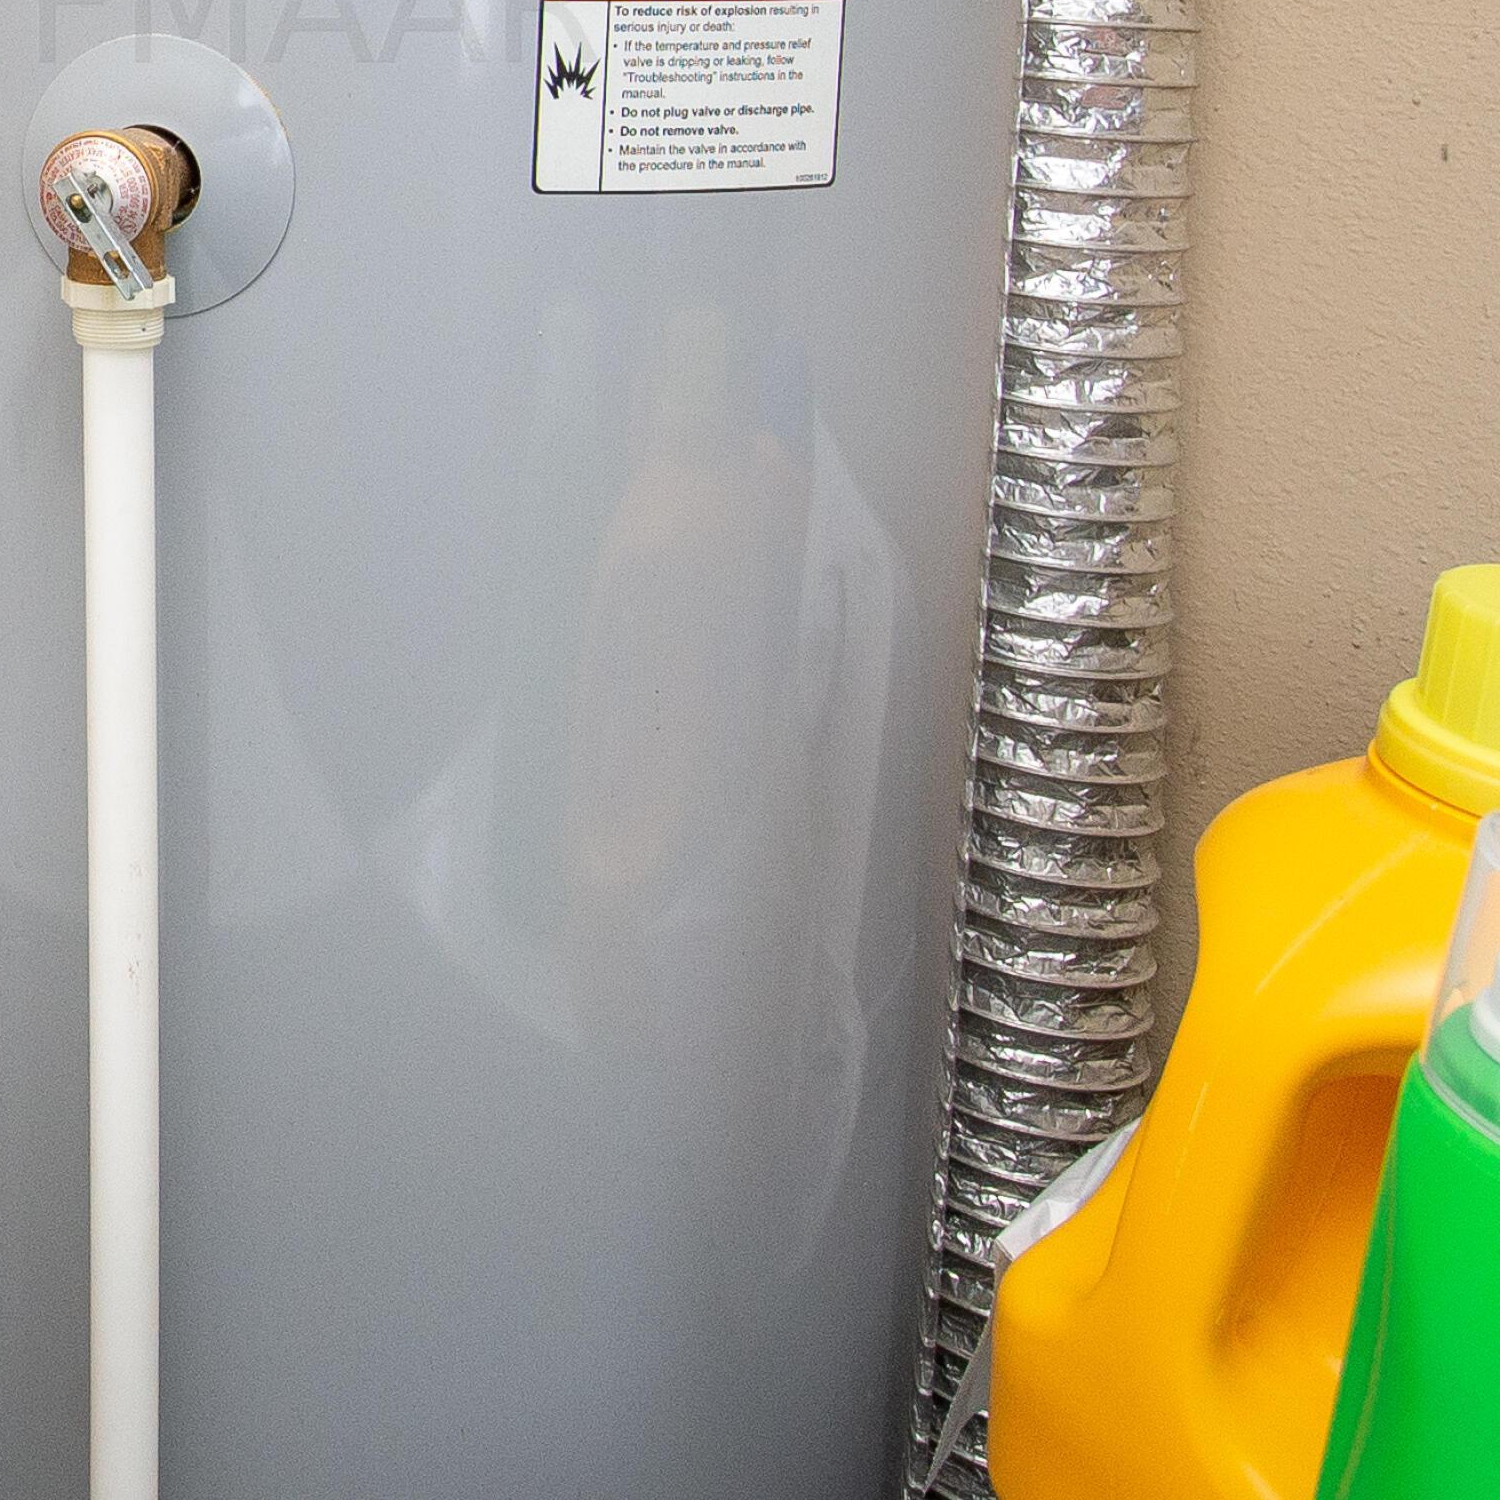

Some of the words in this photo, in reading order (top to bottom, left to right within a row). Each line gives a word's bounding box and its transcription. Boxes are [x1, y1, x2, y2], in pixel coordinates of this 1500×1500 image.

[614, 5, 629, 16] To
[632, 5, 672, 16] reduce
[676, 5, 697, 16] risk
[700, 5, 711, 16] of
[714, 5, 766, 17] explosion
[768, 5, 809, 17] resulting
[810, 5, 819, 14] in
[613, 22, 654, 32] serious
[657, 22, 686, 34] injury
[688, 23, 700, 32] or
[624, 40, 631, 51] If
[634, 40, 652, 51] the
[722, 40, 741, 50] and
[743, 40, 786, 52] pressure
[788, 38, 811, 49] relief
[623, 56, 652, 67] valve
[655, 56, 664, 66] is
[667, 56, 710, 68] dripping
[712, 57, 723, 66] or
[777, 70, 786, 80] in
[788, 70, 803, 79] the
[621, 106, 637, 117] Do
[640, 107, 660, 117] not
[663, 106, 688, 119] plug
[692, 106, 720, 116] valve
[723, 107, 735, 116] or
[737, 104, 788, 117] discharge
[620, 125, 637, 136] Do
[639, 125, 659, 136] not
[662, 127, 704, 136] remove
[619, 143, 665, 155] Maintain
[668, 143, 685, 154] the
[688, 143, 715, 154] valve
[718, 143, 727, 153] in
[730, 141, 785, 153] accordance
[788, 140, 806, 150] with
[618, 160, 636, 171] the
[638, 160, 693, 172] procedure
[695, 160, 705, 169] in
[708, 159, 724, 169] the
